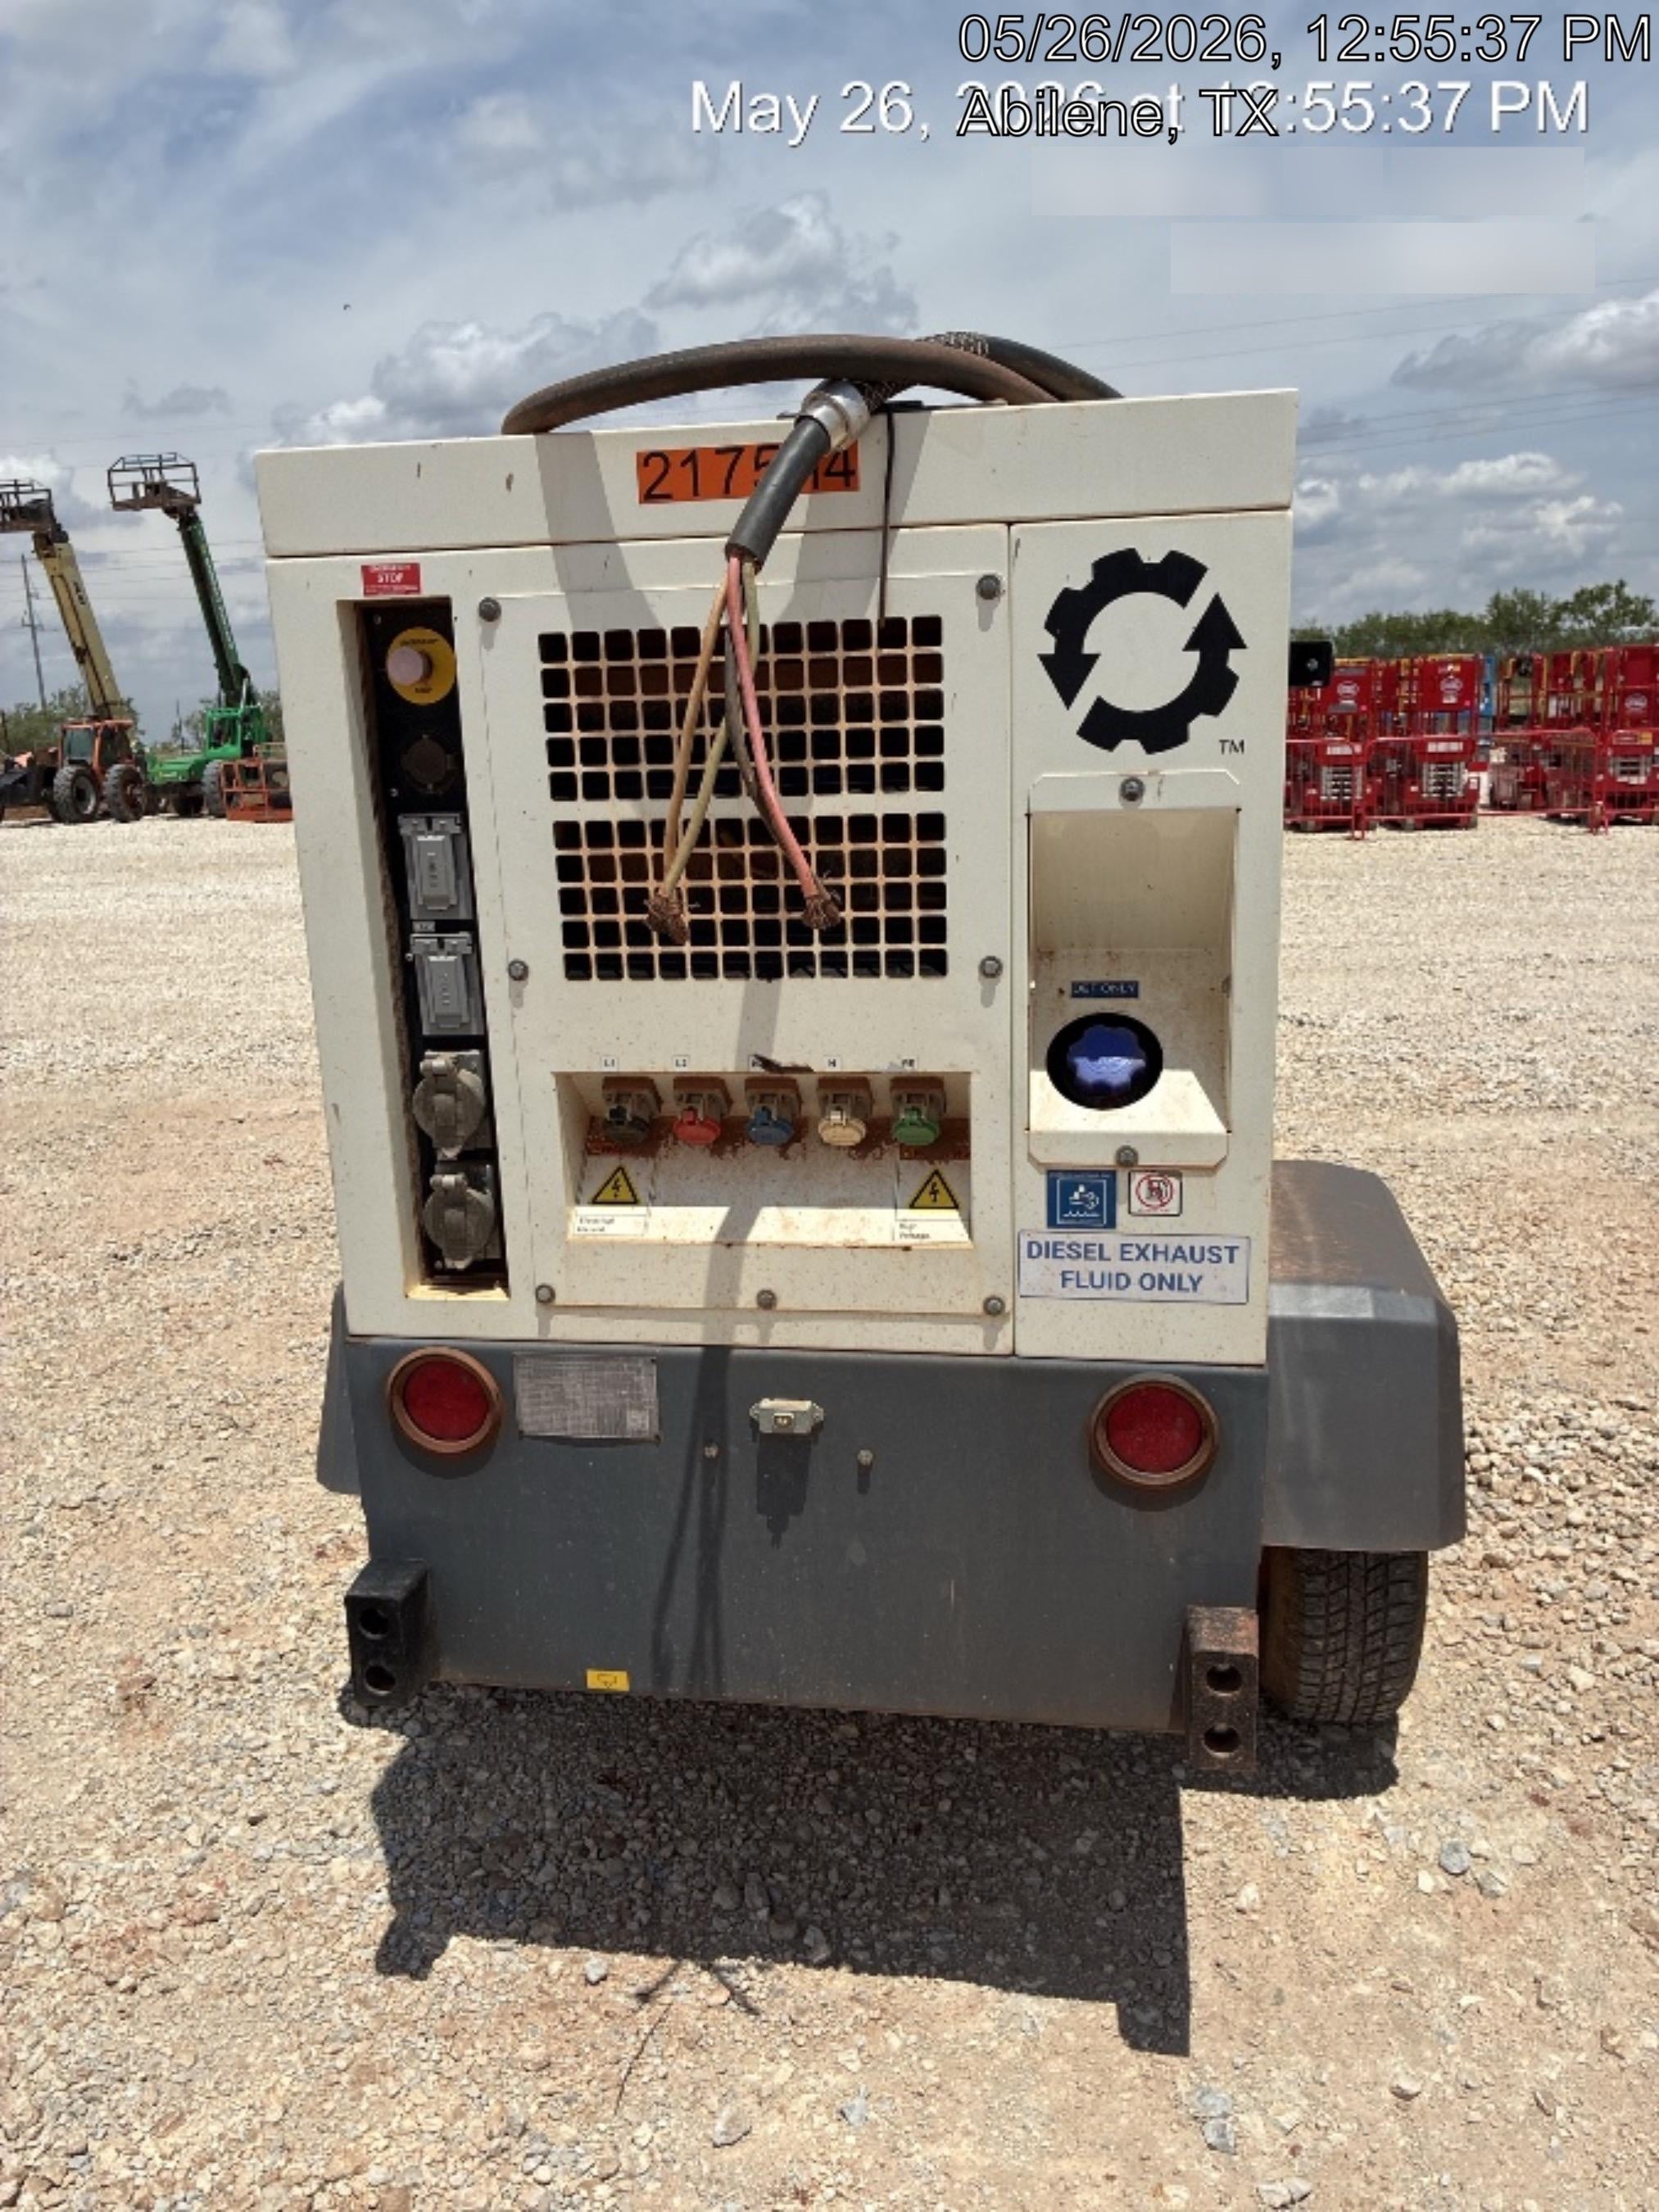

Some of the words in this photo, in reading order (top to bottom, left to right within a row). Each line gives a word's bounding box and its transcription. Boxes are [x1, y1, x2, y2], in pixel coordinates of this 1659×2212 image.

[1218, 738, 1244, 755] TM
[1027, 1240, 1111, 1262] DIESEL
[1119, 1243, 1240, 1264] EXHAUST
[1060, 1271, 1131, 1290] FLUID
[1139, 1272, 1203, 1293] ONLY
